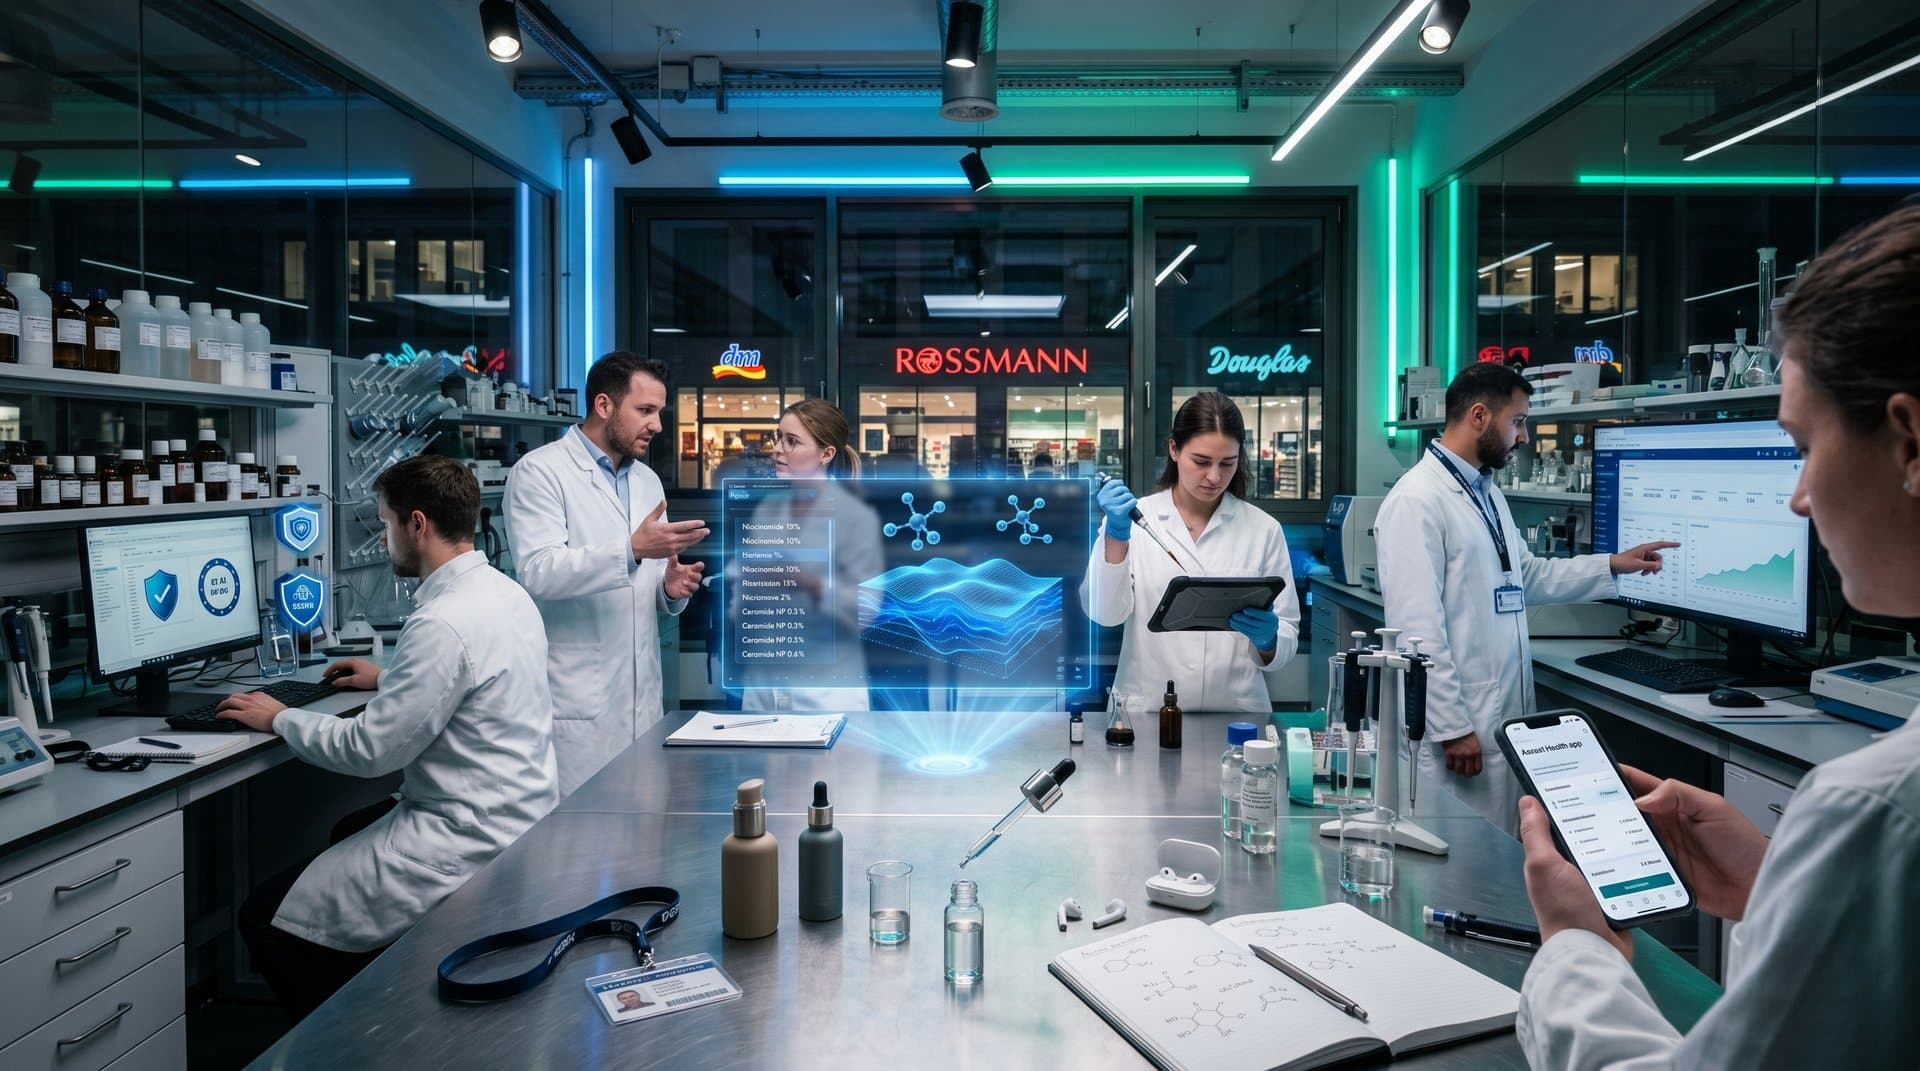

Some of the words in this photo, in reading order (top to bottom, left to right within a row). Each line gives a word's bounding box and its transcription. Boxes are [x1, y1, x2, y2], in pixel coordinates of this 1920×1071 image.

[719, 343, 761, 368] dm
[895, 346, 1087, 375] ROSSMANN
[1207, 344, 1312, 382] Douglas
[776, 607, 786, 616] NP
[776, 622, 786, 630] NP
[776, 636, 786, 645] NP
[776, 650, 786, 659] NP
[1545, 742, 1569, 753] Health
[1569, 741, 1583, 749] app
